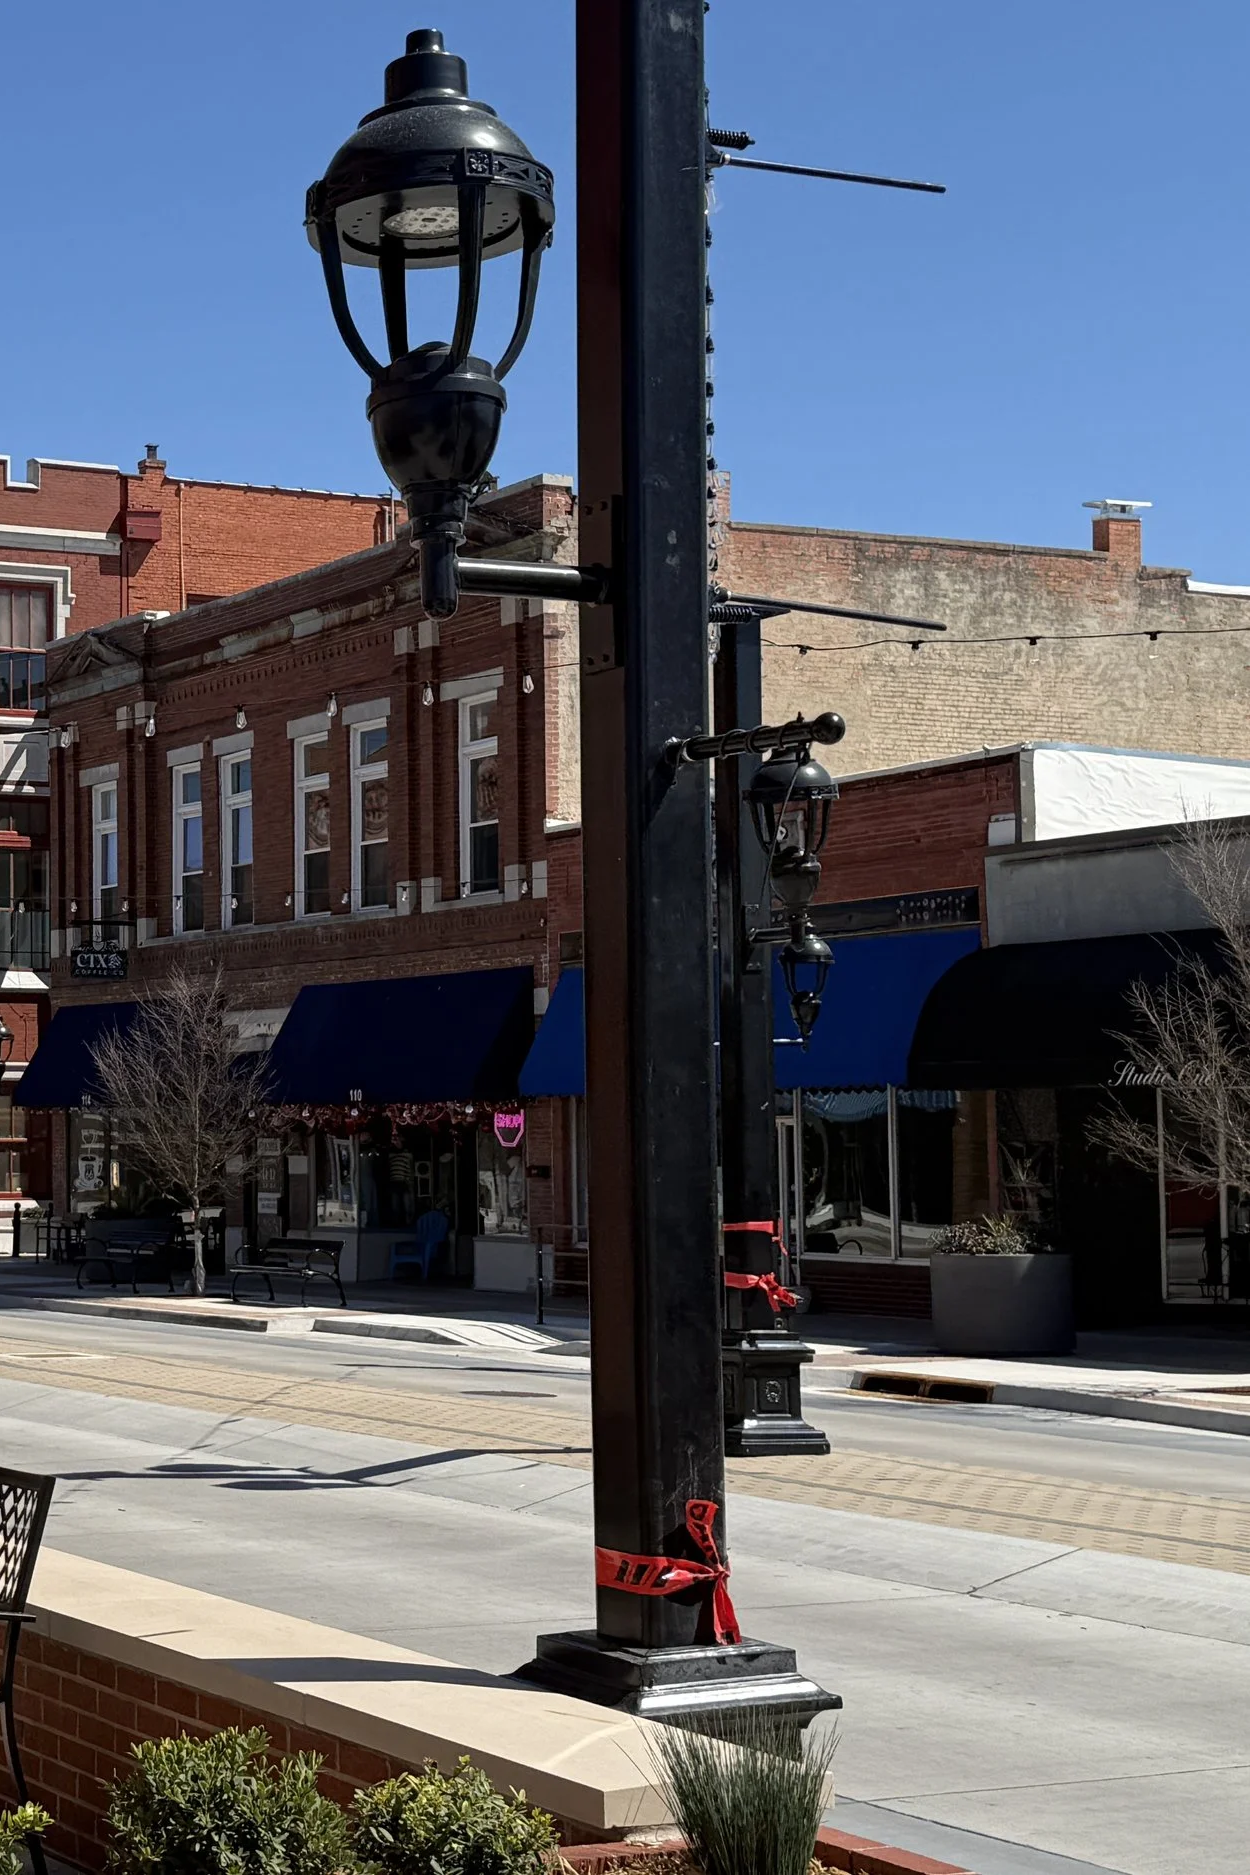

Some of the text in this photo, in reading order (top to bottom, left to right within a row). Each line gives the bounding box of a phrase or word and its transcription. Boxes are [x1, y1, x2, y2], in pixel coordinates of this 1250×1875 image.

[76, 953, 107, 968] CTX
[1108, 1059, 1172, 1087] Studio
[349, 1088, 362, 1101] 110
